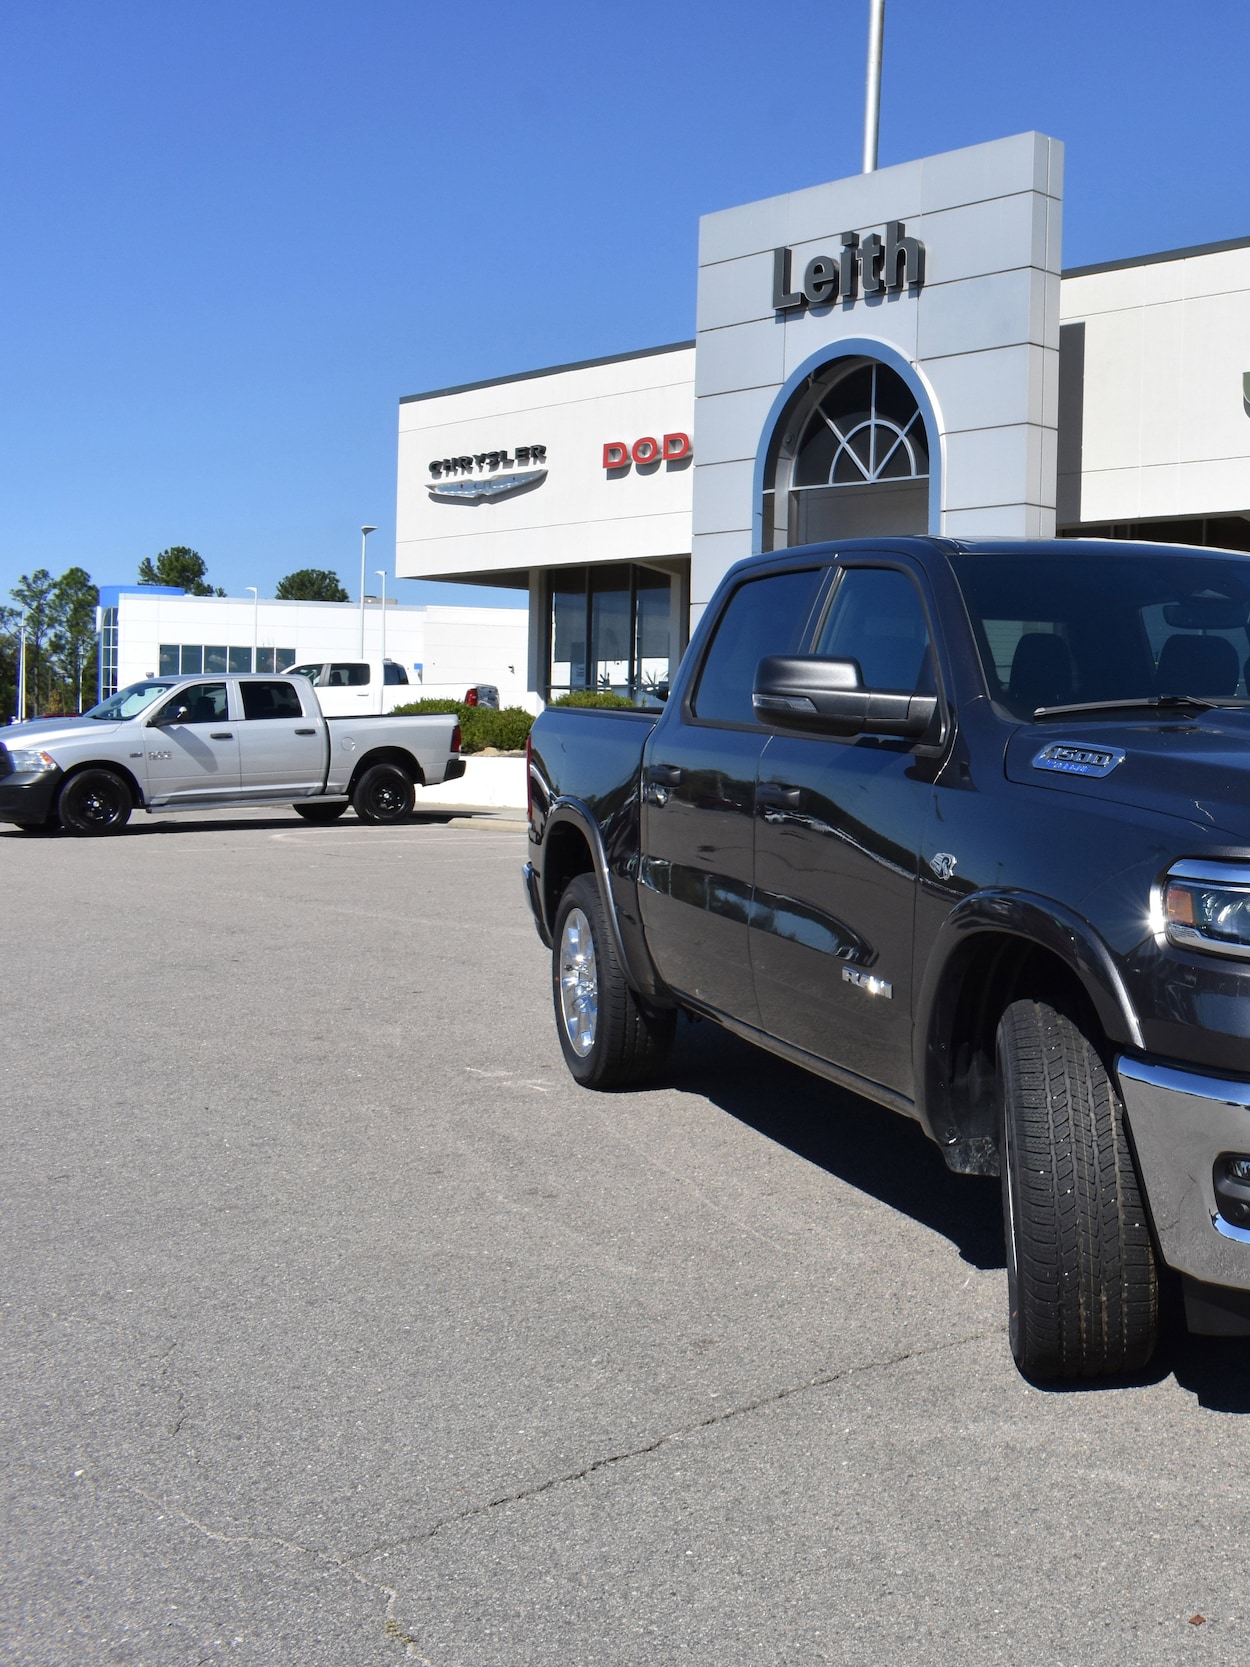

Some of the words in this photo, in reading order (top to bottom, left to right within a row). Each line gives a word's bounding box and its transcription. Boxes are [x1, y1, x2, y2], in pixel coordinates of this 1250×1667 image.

[773, 221, 925, 310] Leith
[428, 444, 547, 475] CHRYSLER
[603, 433, 691, 468] DOD
[1050, 747, 1110, 768] 1500
[842, 966, 893, 999] RAM
